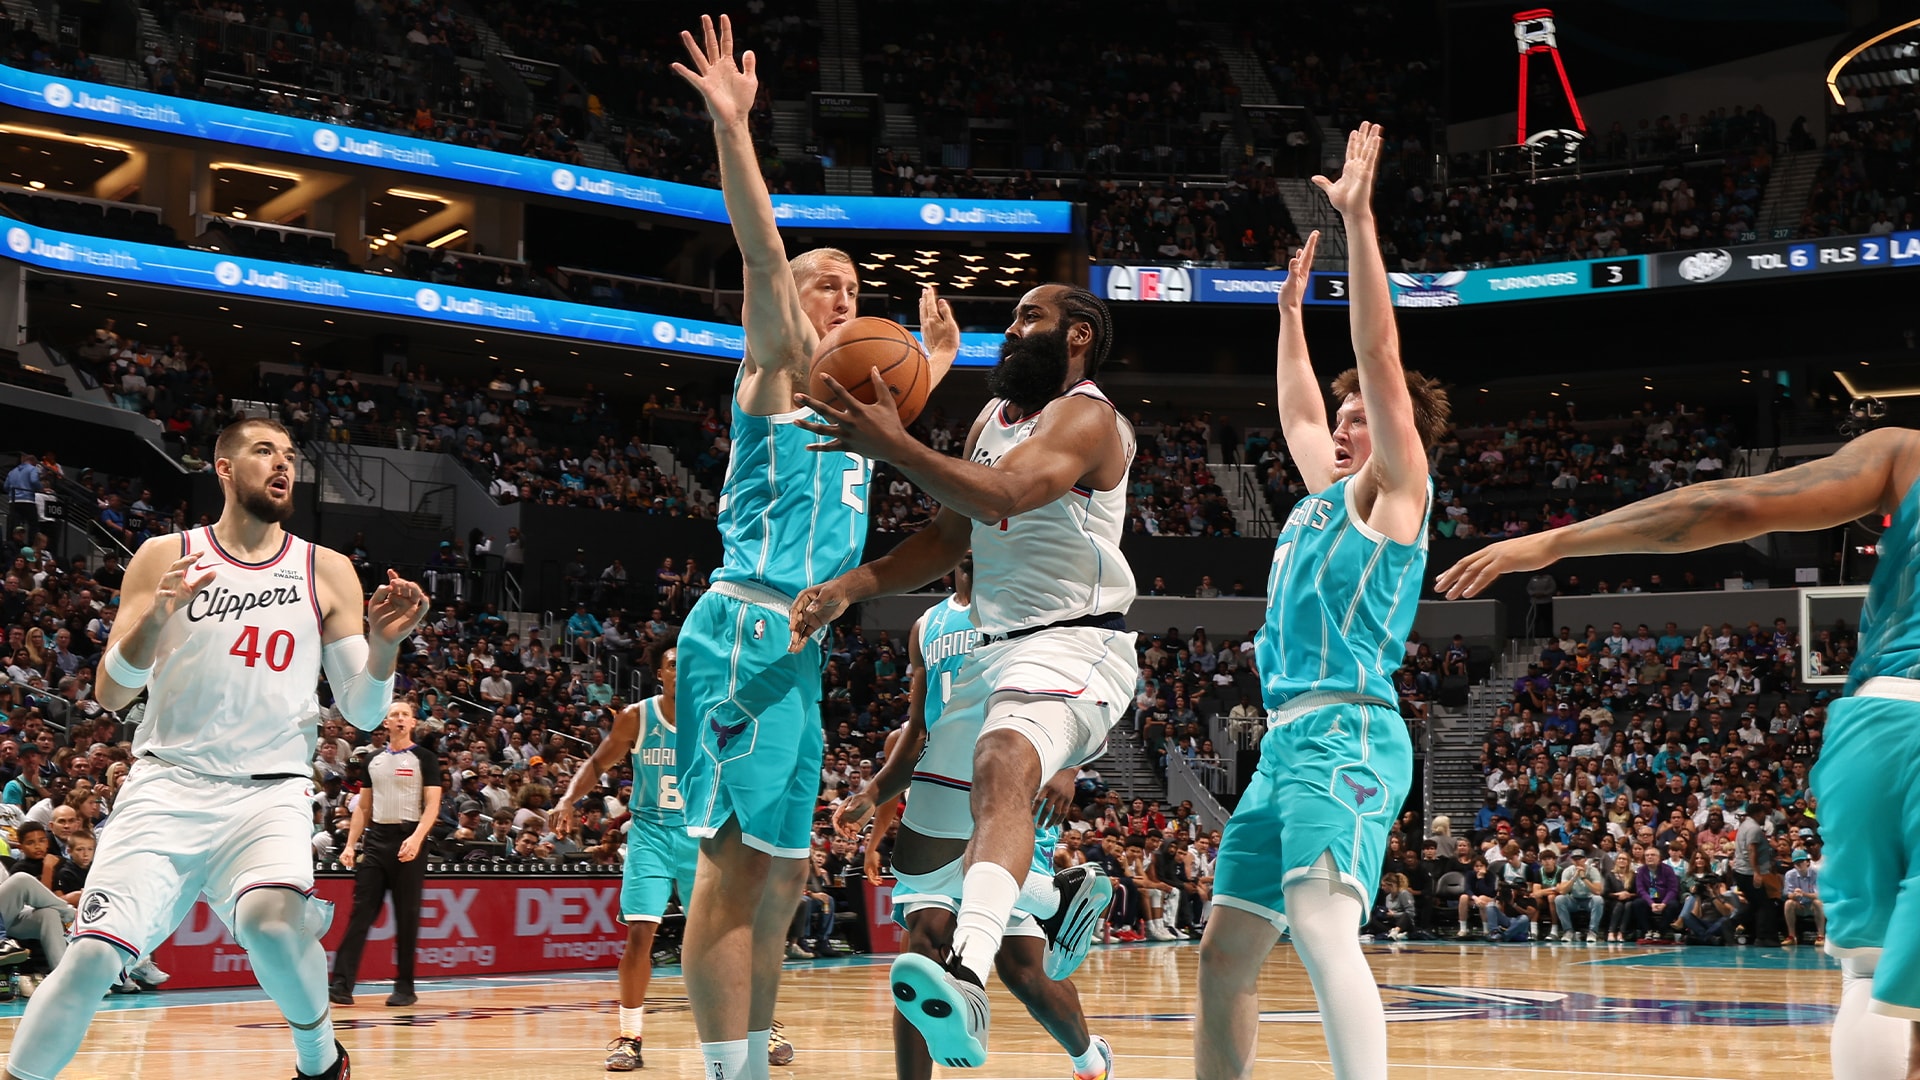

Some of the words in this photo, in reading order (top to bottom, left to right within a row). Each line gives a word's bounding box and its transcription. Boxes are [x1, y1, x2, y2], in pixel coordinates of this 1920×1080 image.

[1741, 231, 1756, 241] 216
[1774, 228, 1789, 239] 217
[1747, 253, 1788, 271] TOL
[1789, 249, 1809, 268] 6
[1820, 246, 1857, 265] FLS
[1862, 242, 1880, 261] 2
[1487, 270, 1578, 291] TURNOVERS
[1606, 265, 1624, 284] 3
[1328, 279, 1345, 297] 3
[47, 505, 62, 516] 106
[128, 518, 142, 528] 107
[273, 572, 304, 581] RWANDA
[279, 568, 298, 576] VISIT
[187, 584, 302, 622] Clippers
[229, 624, 296, 673] 40
[514, 886, 618, 937] DEX
